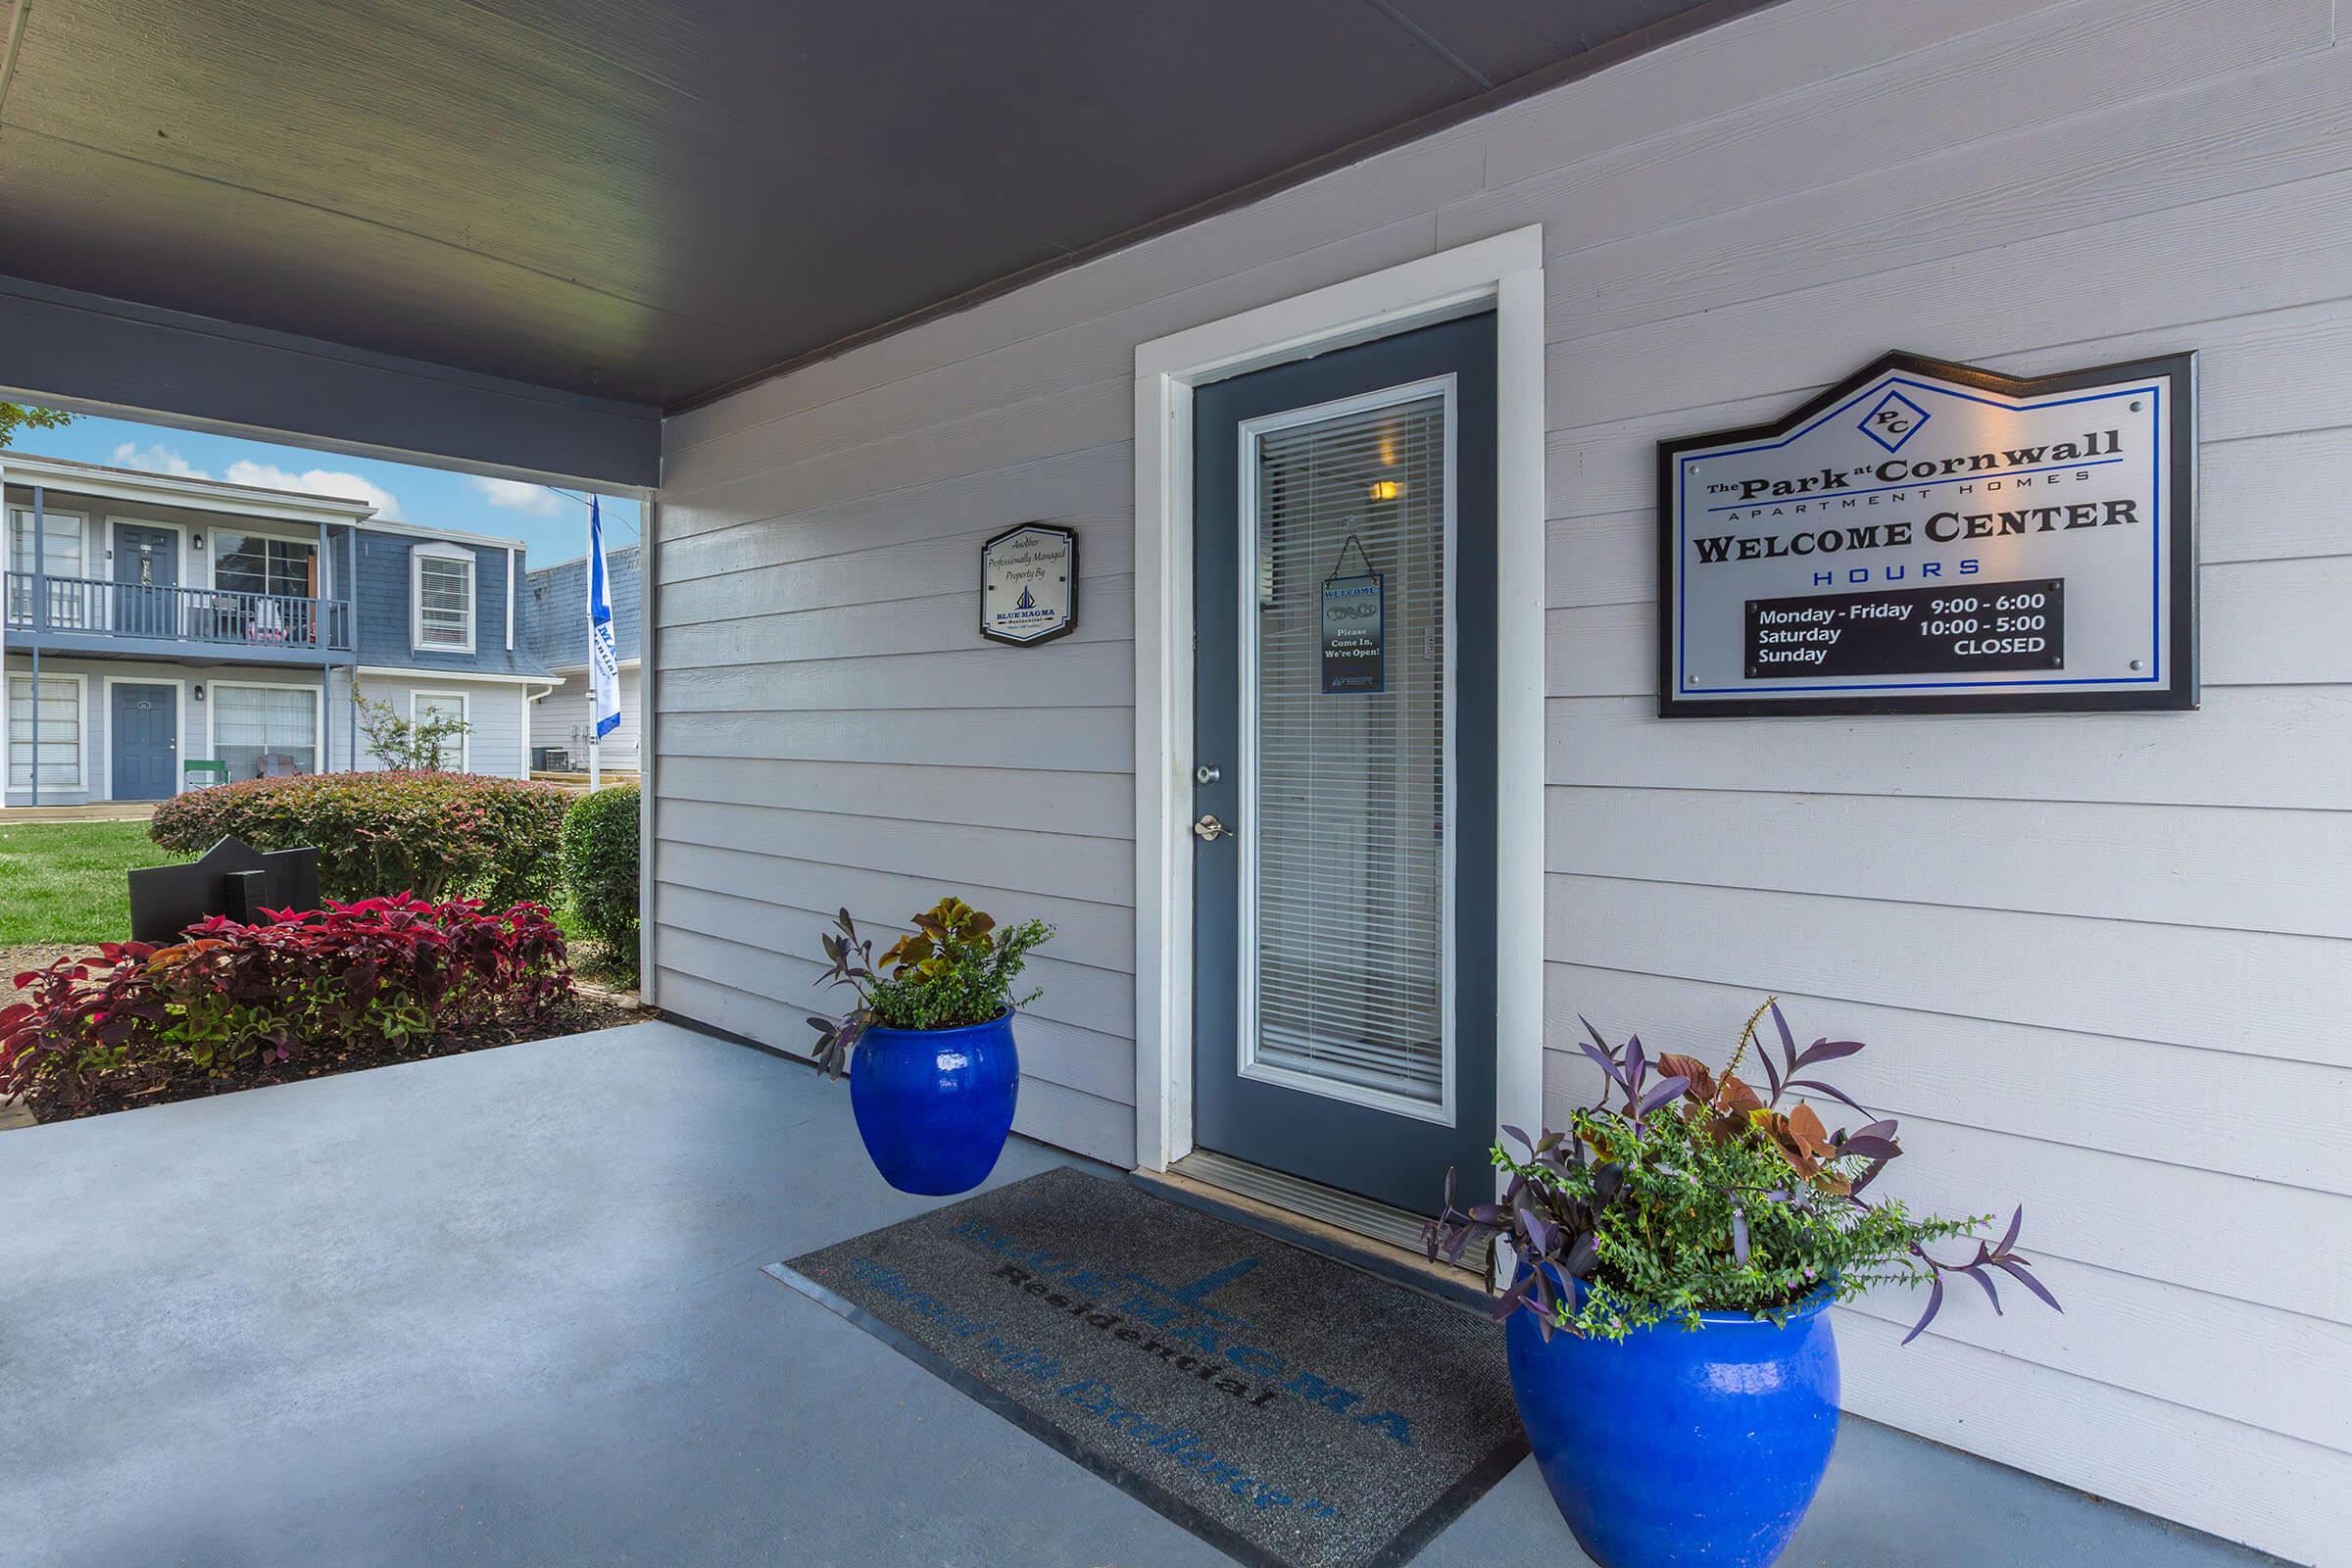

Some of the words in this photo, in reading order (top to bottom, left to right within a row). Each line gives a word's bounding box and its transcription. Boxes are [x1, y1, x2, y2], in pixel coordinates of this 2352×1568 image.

[1707, 482, 1739, 494] The
[1739, 468, 1850, 501] Park
[1853, 464, 1873, 476] at
[1875, 429, 2124, 482] Cornwall
[1729, 490, 1931, 521] APARTMENT
[1960, 471, 2089, 494] HOMES
[1692, 522, 1912, 564] WELCOME
[1925, 500, 2139, 542] CENTER
[1033, 548, 1066, 564] Managed
[1005, 570, 1033, 583] Property
[1035, 567, 1045, 580] By
[1814, 559, 1980, 586] HOURS
[1325, 587, 1380, 598] WELCOME
[1759, 608, 1835, 624] Monday
[1849, 604, 1913, 622] Friday
[1931, 597, 1978, 614] 9:00
[1995, 593, 2045, 611] 6:00
[1759, 628, 1841, 645] Saturday
[1920, 618, 1978, 636] 10:00
[1996, 615, 2045, 632] 5:00
[1352, 648, 1380, 658] Open!
[1759, 648, 1828, 664] Sunday
[1954, 637, 2045, 655] CLOSED
[996, 1265, 1276, 1407] Residential
[1120, 1294, 1414, 1446] MAGMA
